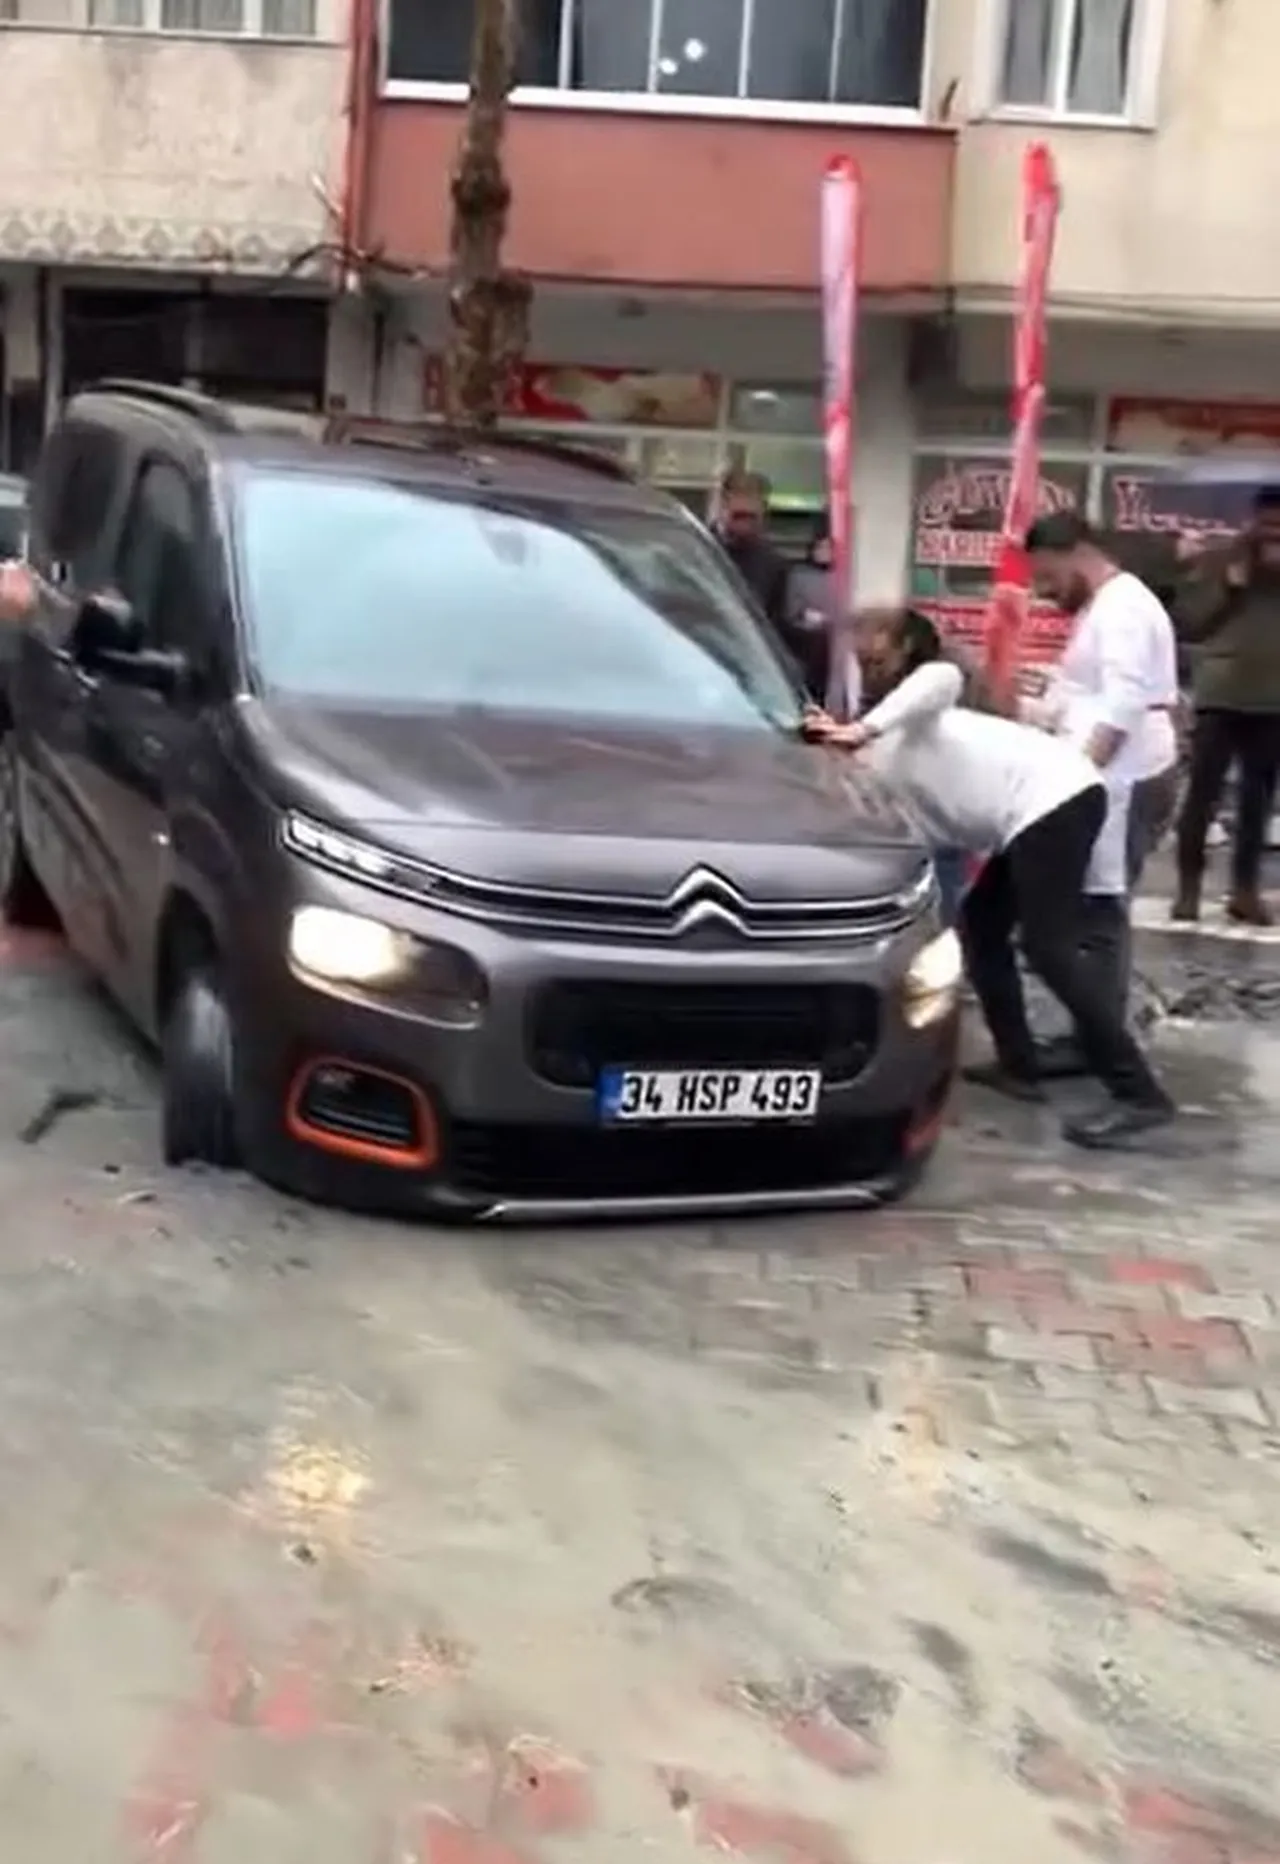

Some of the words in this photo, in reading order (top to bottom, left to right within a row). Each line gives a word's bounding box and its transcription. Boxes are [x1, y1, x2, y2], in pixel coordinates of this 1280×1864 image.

[621, 1075, 664, 1113] 34
[676, 1075, 741, 1112] HSP
[751, 1075, 813, 1112] 493
